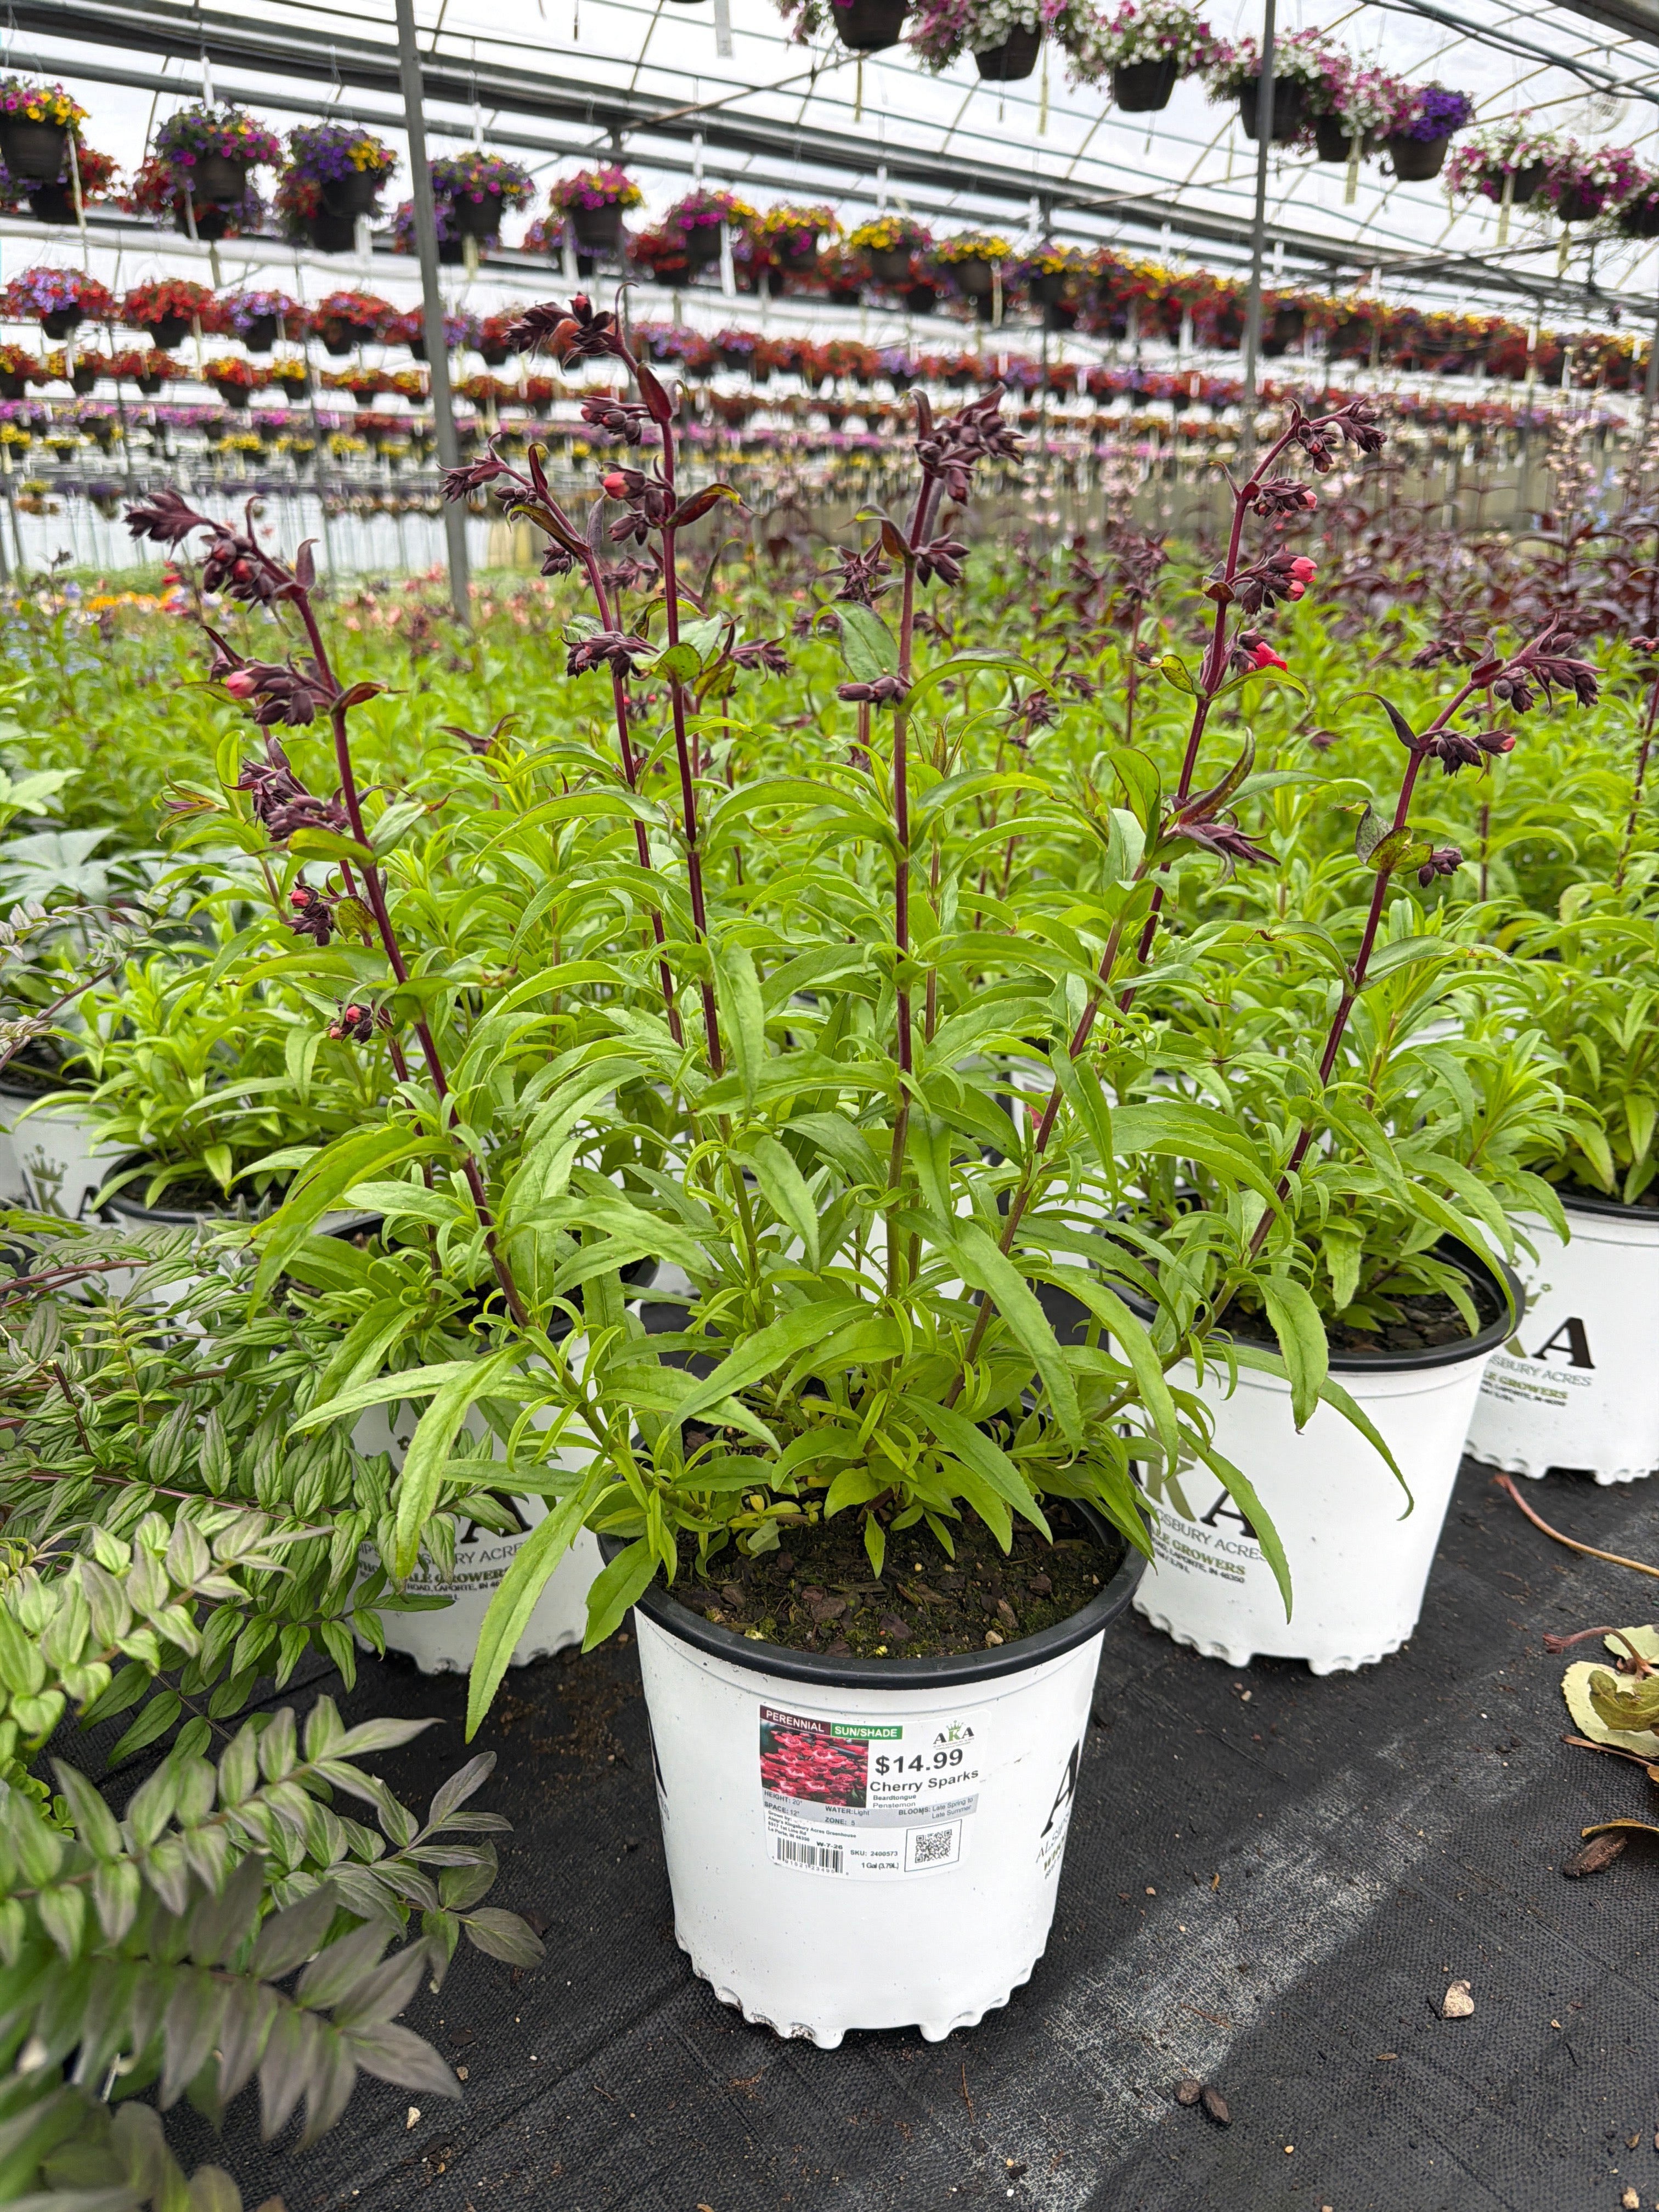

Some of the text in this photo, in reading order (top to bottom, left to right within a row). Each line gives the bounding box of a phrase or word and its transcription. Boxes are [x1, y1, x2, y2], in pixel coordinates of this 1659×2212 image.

[1172, 1539, 1246, 1575] GROWERS
[766, 1709, 898, 1737] PERENNIAL SUN/SHADE
[933, 1726, 975, 1745] AKA
[875, 1748, 963, 1776] $14.99
[870, 1770, 979, 1793] Cherry Sparks
[764, 1790, 791, 1803] HEIGHT:
[764, 1801, 789, 1814] SPACE:
[898, 1807, 931, 1816] BLOOMS:
[932, 1804, 946, 1812] Late
[947, 1799, 966, 1809] Spring
[946, 1805, 972, 1816] Summer
[768, 1810, 783, 1819] Grown
[825, 1816, 847, 1825] ZONE:
[785, 1821, 809, 1831] Kingsbury
[816, 1841, 843, 1849] W-7-26
